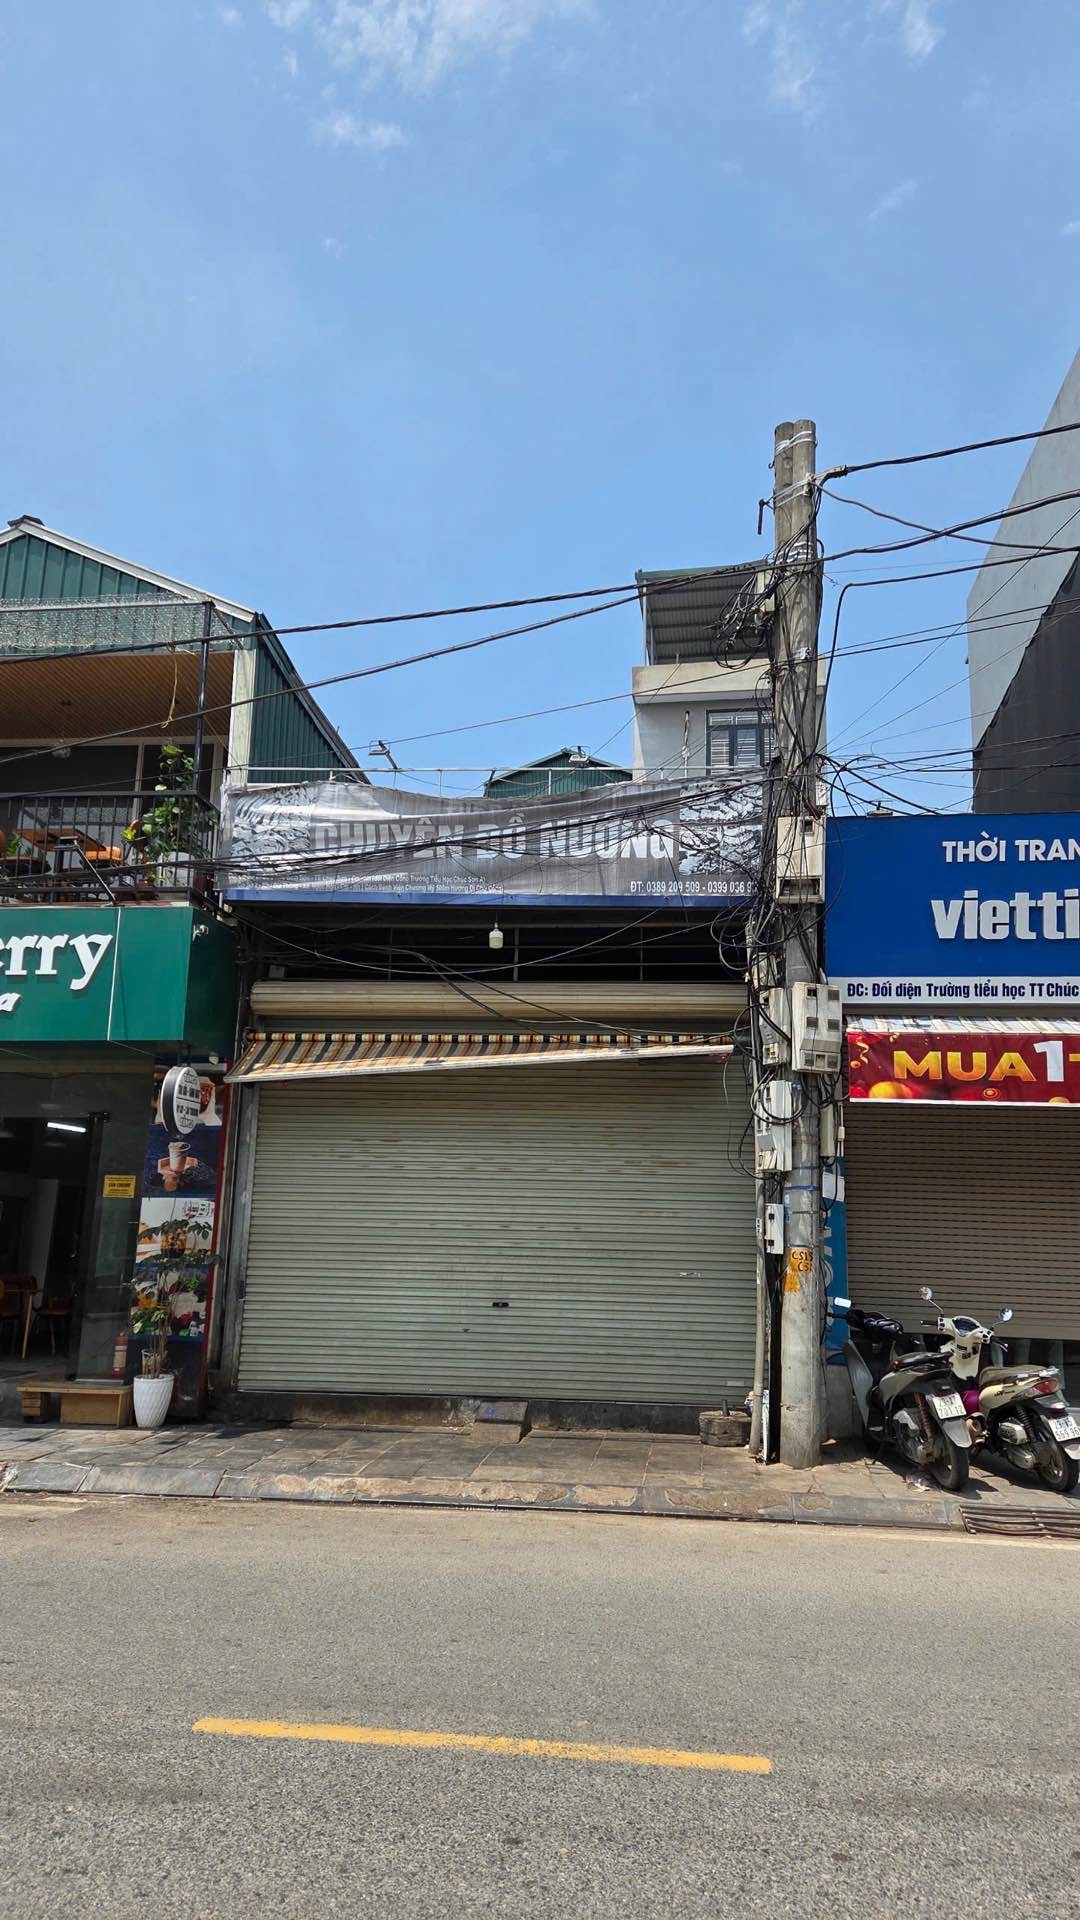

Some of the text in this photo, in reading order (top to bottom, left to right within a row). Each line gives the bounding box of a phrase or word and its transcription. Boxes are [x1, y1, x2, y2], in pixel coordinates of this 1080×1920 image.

[942, 831, 1006, 863] THỜI
[630, 881, 644, 893] ĐT:
[646, 881, 666, 893] 0389
[668, 881, 683, 893] 209
[685, 881, 700, 893] 509
[707, 881, 727, 893] 0399
[931, 888, 1080, 941] vietti
[0, 933, 113, 990] rry
[847, 979, 1079, 1000] ĐC: Đối diện Trường tiểu học TT Chúc
[893, 1040, 1065, 1083] MUA 1
